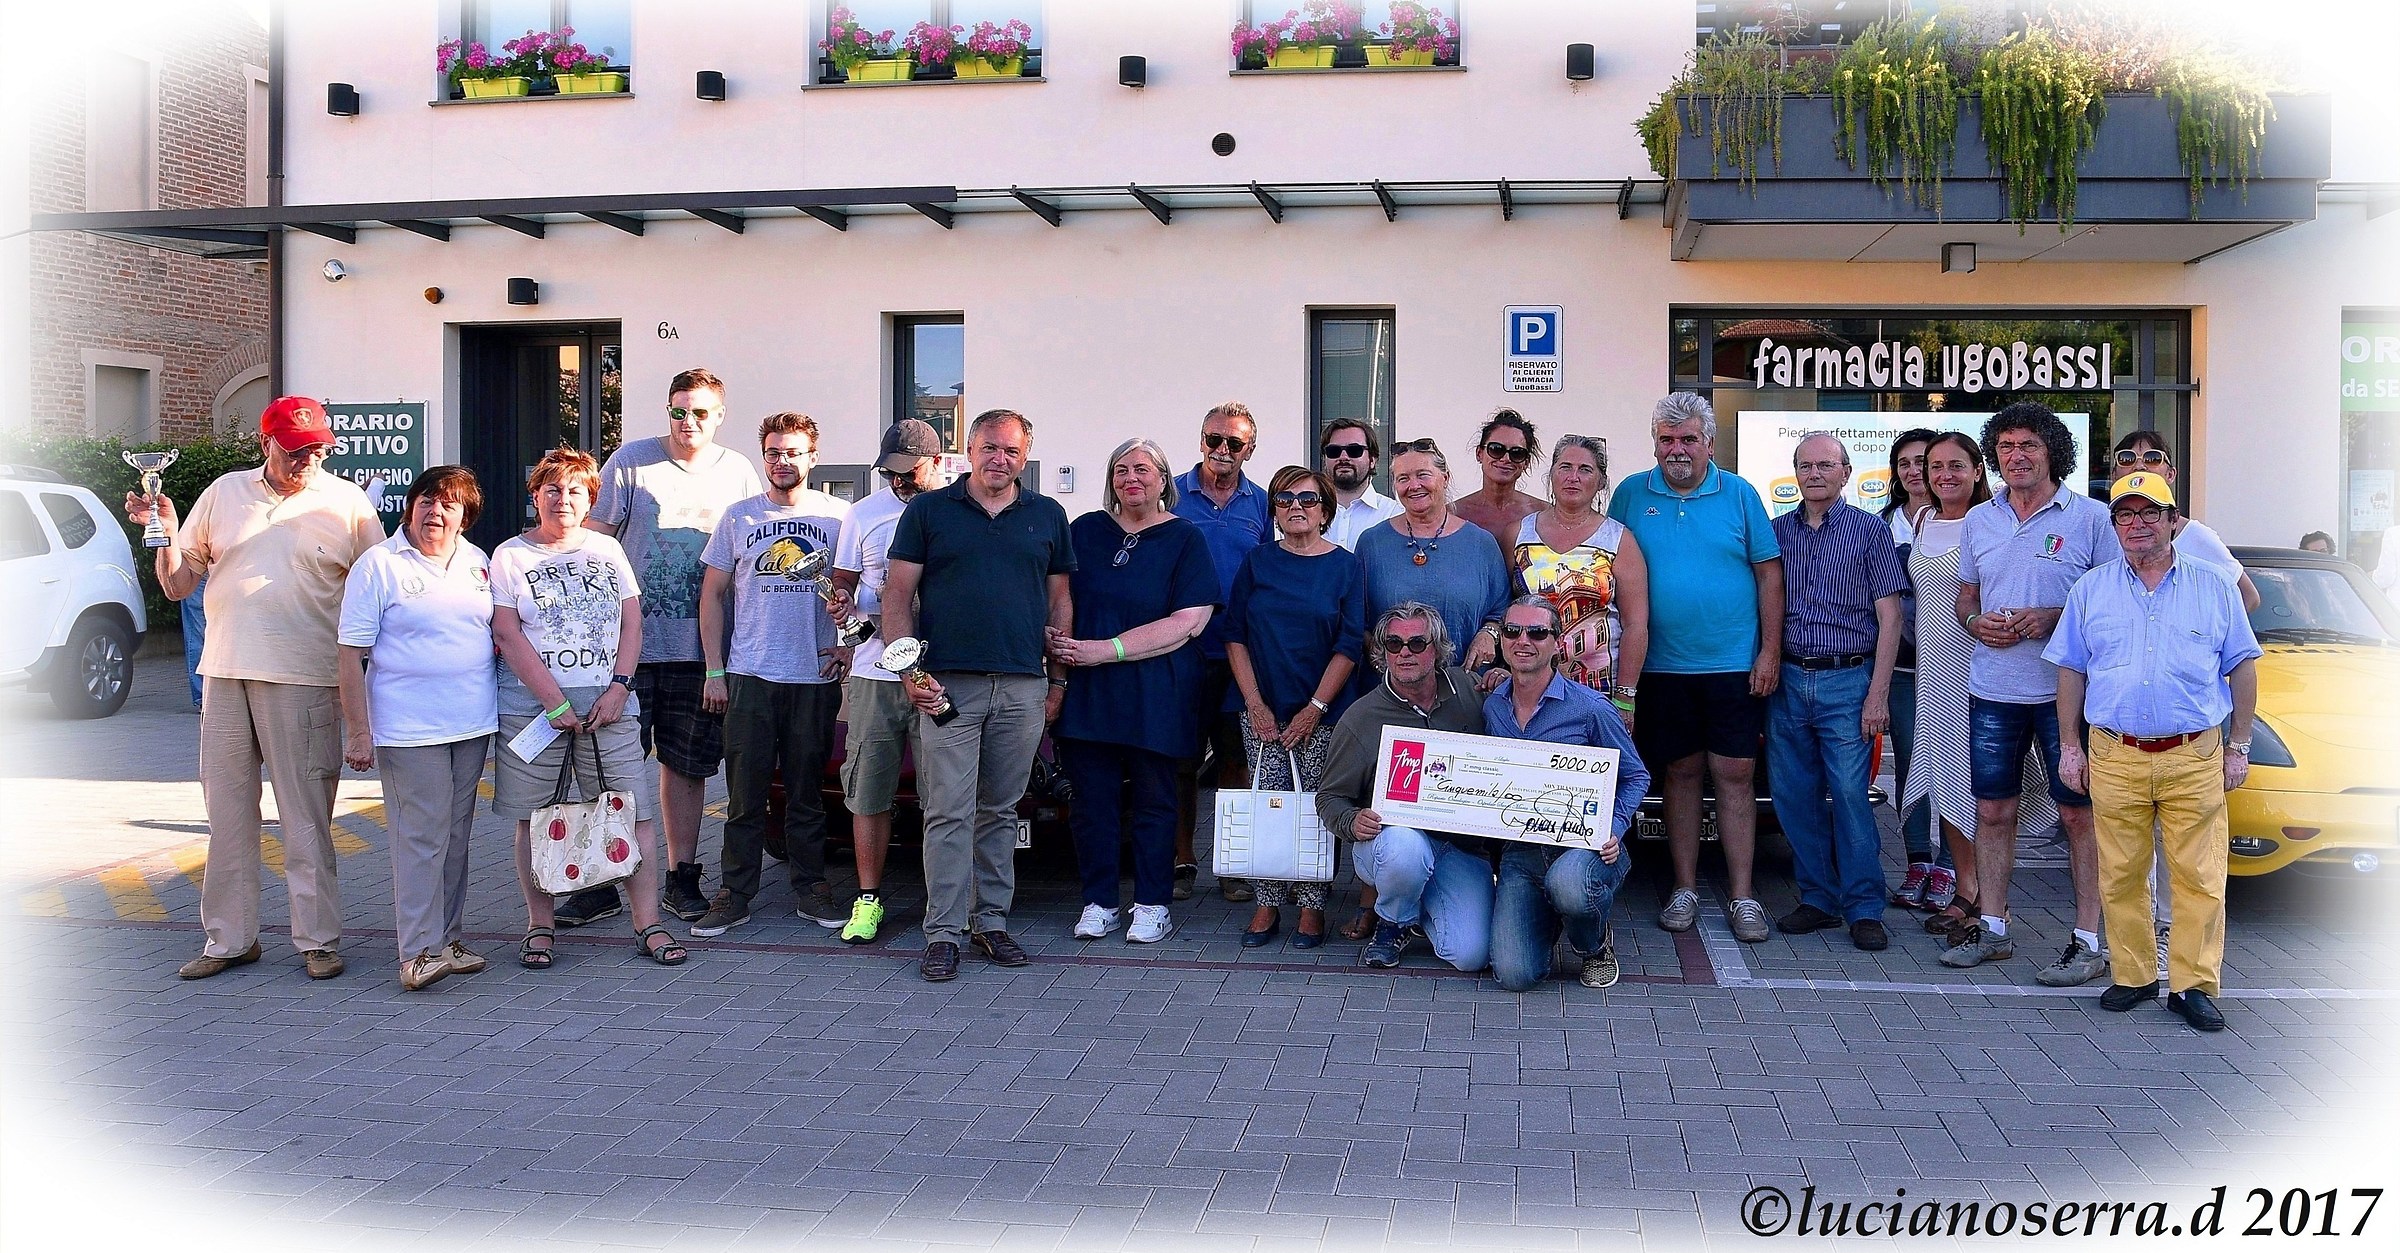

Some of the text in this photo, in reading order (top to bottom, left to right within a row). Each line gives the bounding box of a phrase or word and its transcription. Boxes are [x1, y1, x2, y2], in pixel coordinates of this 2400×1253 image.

[657, 321, 680, 340] 6A
[1519, 316, 1547, 352] P
[1508, 361, 1558, 369] RISERVATO
[2341, 378, 2369, 398] da
[331, 435, 409, 455] STIVO
[1853, 441, 1887, 454] dopo
[1776, 487, 1797, 496] Scholl
[1862, 482, 1885, 491] Scholl
[746, 521, 829, 549] CALIFORNIA
[524, 560, 616, 585] DRESS
[754, 550, 787, 577] Cal
[530, 575, 619, 600] LIKE
[761, 584, 815, 593] UC BERKELEY
